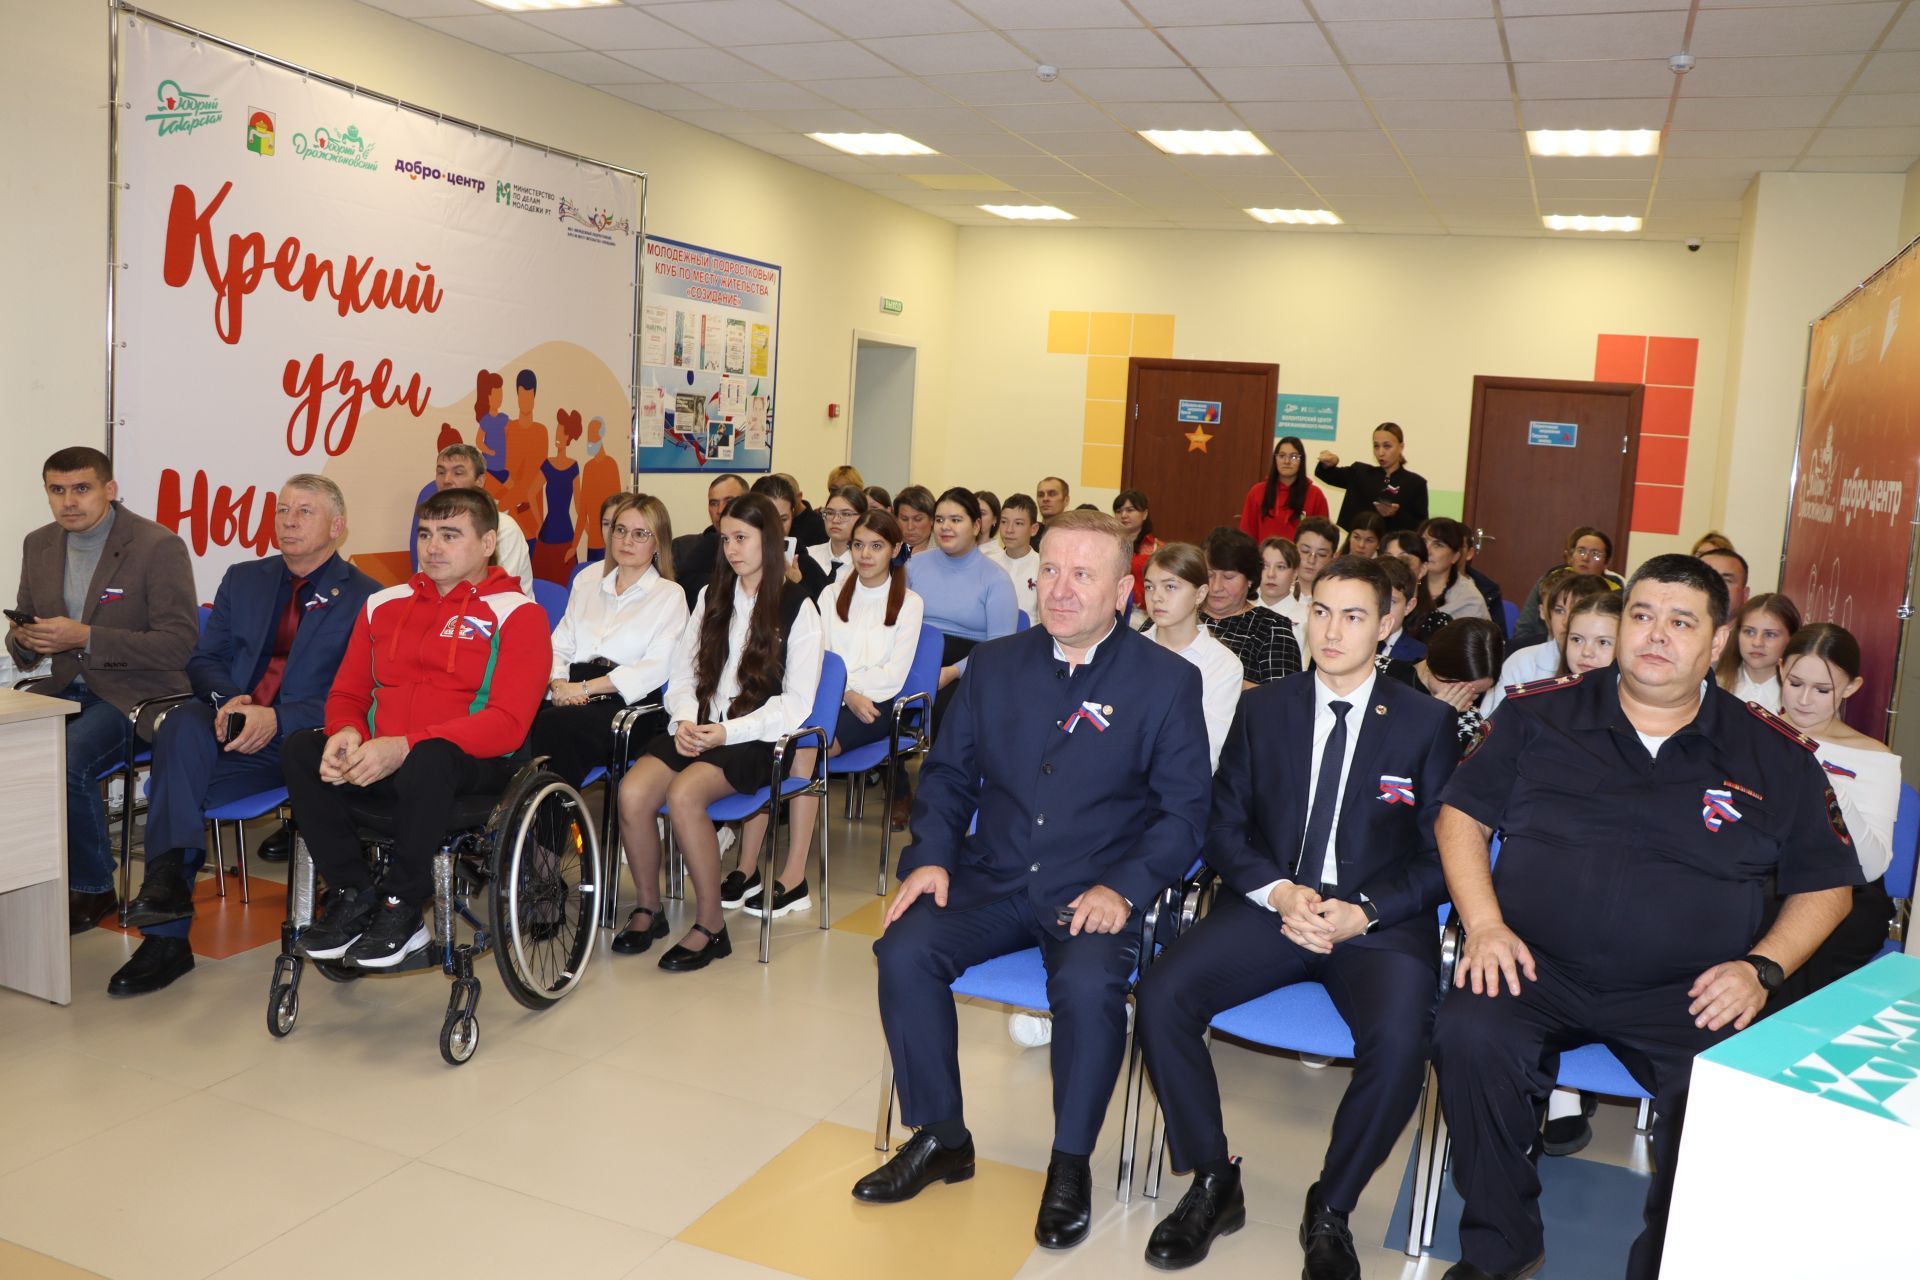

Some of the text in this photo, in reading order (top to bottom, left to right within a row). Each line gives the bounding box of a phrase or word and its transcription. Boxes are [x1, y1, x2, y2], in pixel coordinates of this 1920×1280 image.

[512, 192, 541, 205] ПО ДЕЛАМ
[513, 184, 555, 201] МИНИСТЕРСТВО
[512, 201, 544, 215] МОЛОДЕЖИ
[163, 180, 443, 345] Крепкий
[647, 242, 709, 267] МОЛОДЕЖНЫЙ
[655, 262, 769, 297] КЛУБ ПО МЕСТУ ЖИТЕЛЬСТВА
[686, 286, 742, 306] «СОЗИДАНИЕ»
[282, 353, 432, 457] узел
